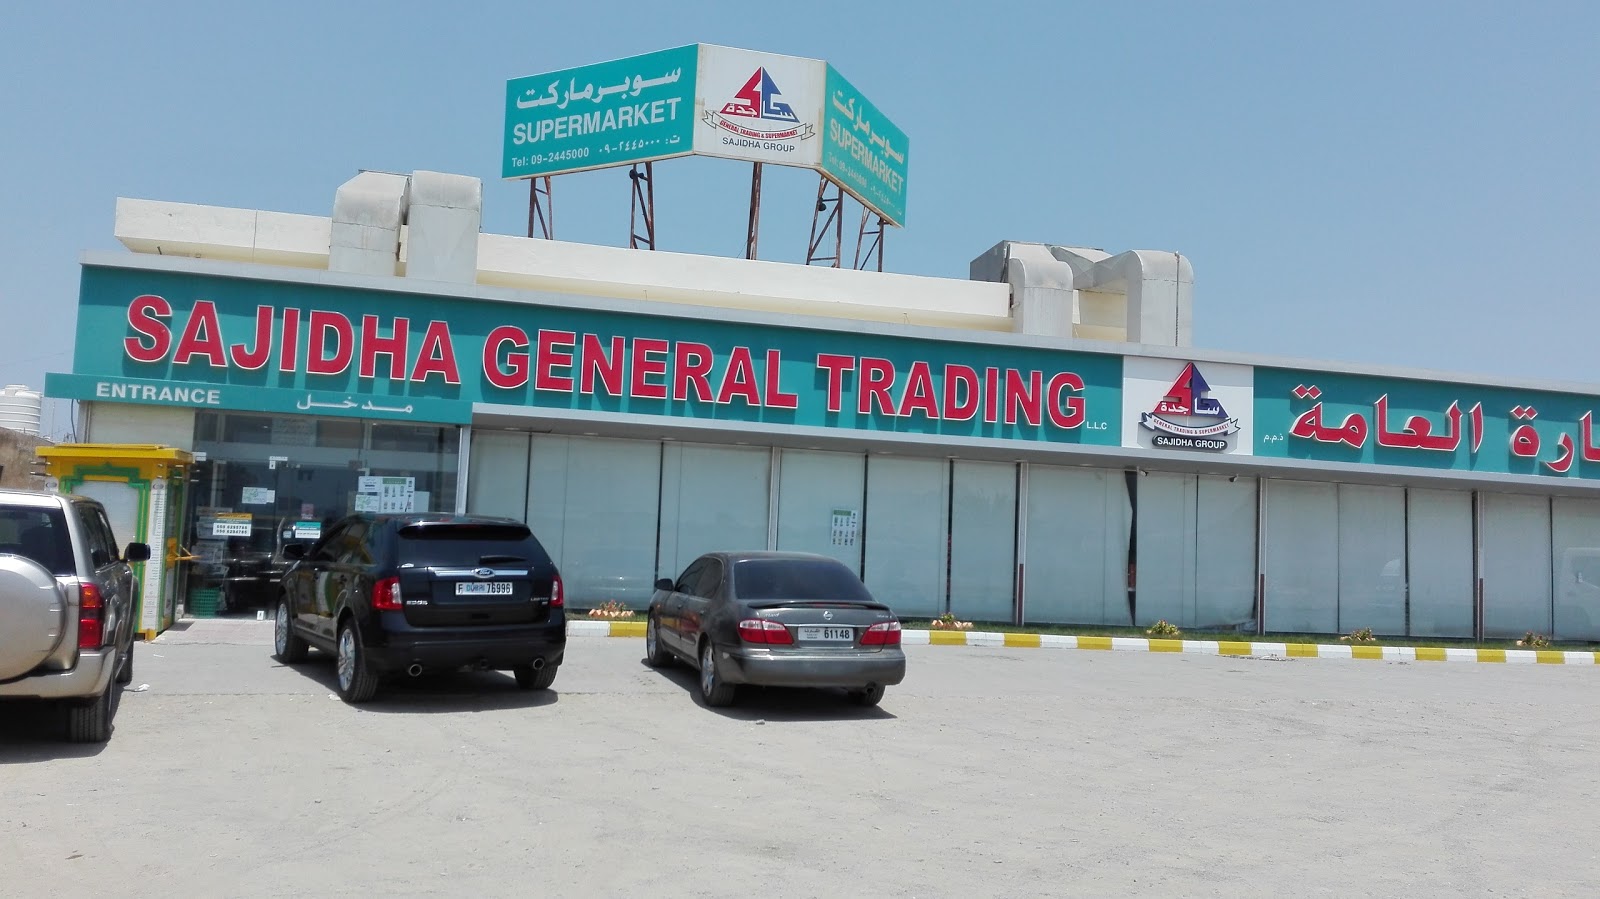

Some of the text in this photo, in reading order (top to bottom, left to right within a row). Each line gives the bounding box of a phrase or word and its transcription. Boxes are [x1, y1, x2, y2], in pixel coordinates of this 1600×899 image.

[516, 67, 682, 109] سوبرماركت
[513, 97, 682, 145] SUPERMARKET
[722, 137, 795, 153] SAJIDHA GROUP
[511, 147, 590, 168] Tel: 09-2445000
[830, 118, 904, 196] SUPERMARKET
[123, 294, 461, 385] SAJIDHA
[482, 325, 799, 409] GENERAL
[817, 353, 1086, 429] TRADING
[96, 382, 221, 405] ENTRANCE
[296, 393, 414, 415] مدخل
[1153, 418, 1173, 431] GENERAL
[1174, 426, 1193, 435] TRADING
[1198, 423, 1230, 435] SUPERMARKET
[1288, 384, 1484, 453] العامة
[1157, 436, 1225, 449] SAJIDHA GROUP
[458, 584, 464, 594] F
[486, 584, 511, 594] 76996
[824, 628, 850, 640] 61148
